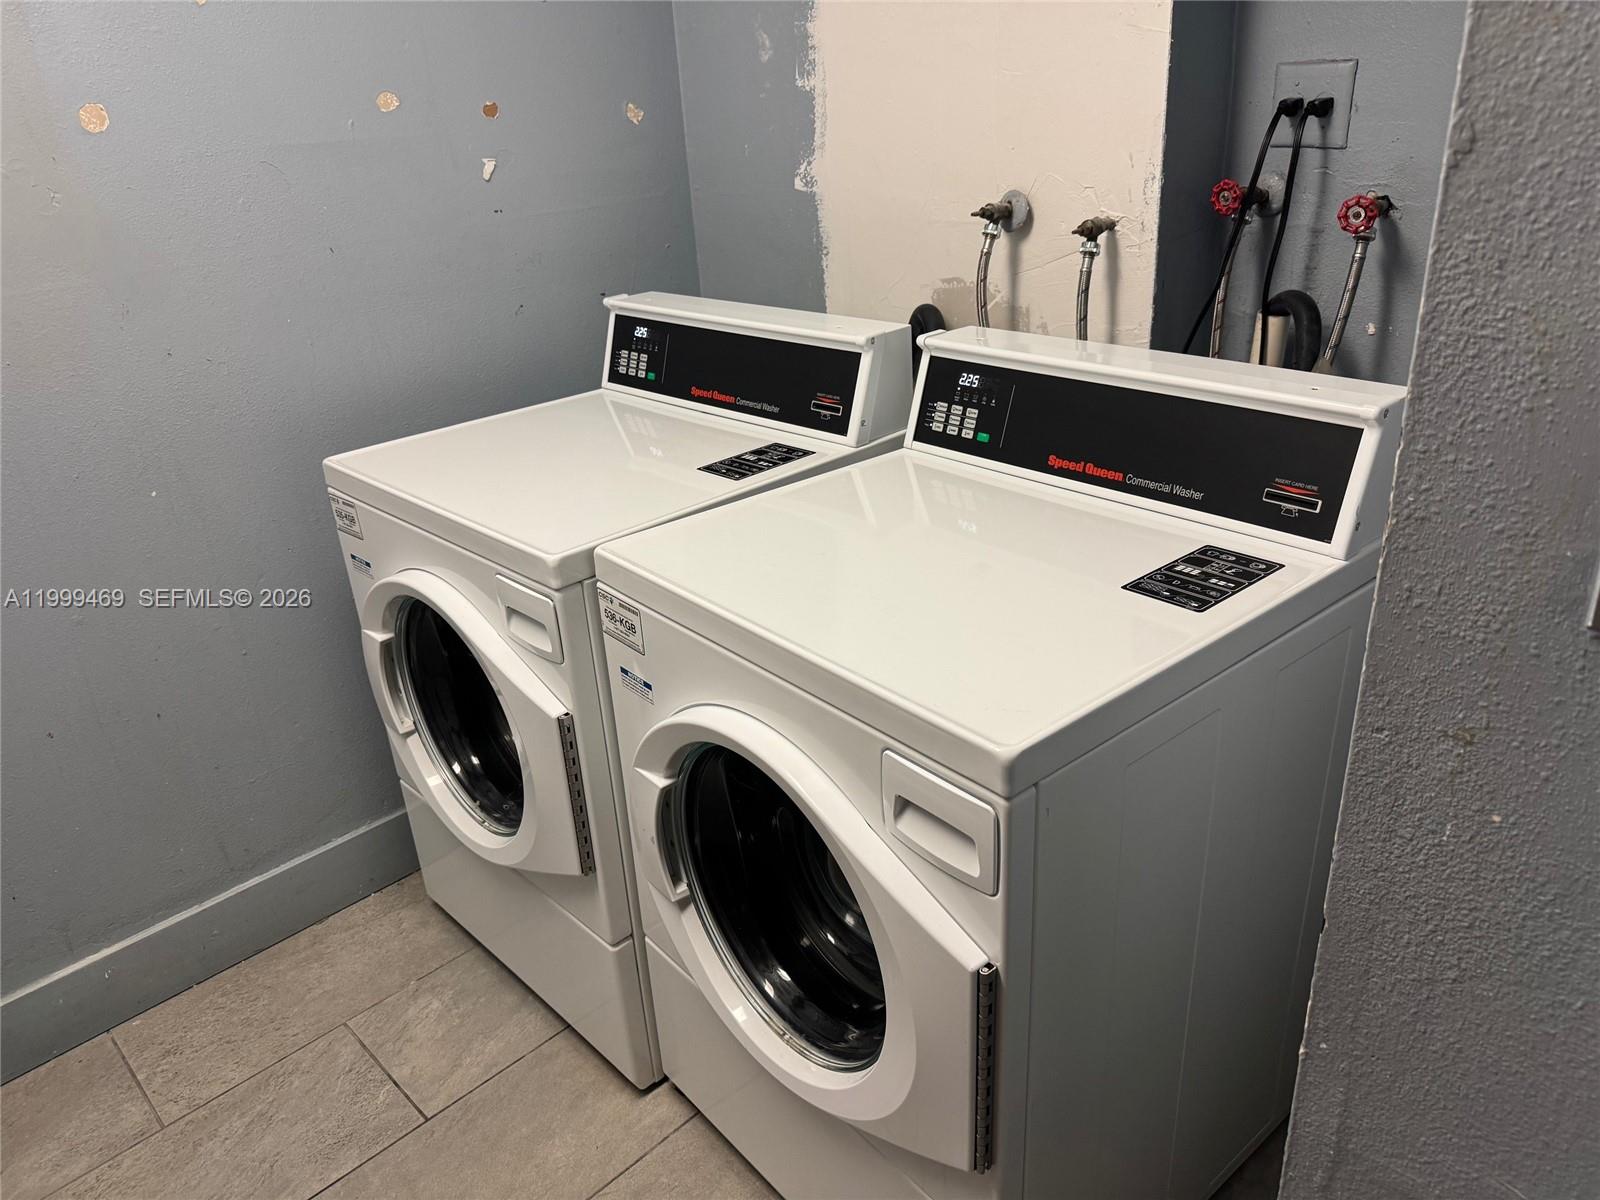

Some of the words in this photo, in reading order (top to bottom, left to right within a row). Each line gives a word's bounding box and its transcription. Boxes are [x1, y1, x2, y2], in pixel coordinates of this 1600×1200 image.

[690, 386, 713, 399] Speed
[712, 390, 736, 404] Queen
[735, 396, 762, 411] Commercial
[762, 402, 781, 414] Washer
[1047, 454, 1085, 473] Speed
[1085, 462, 1124, 482] Queen
[1125, 473, 1172, 493] Commercial
[1172, 484, 1205, 501] Washer
